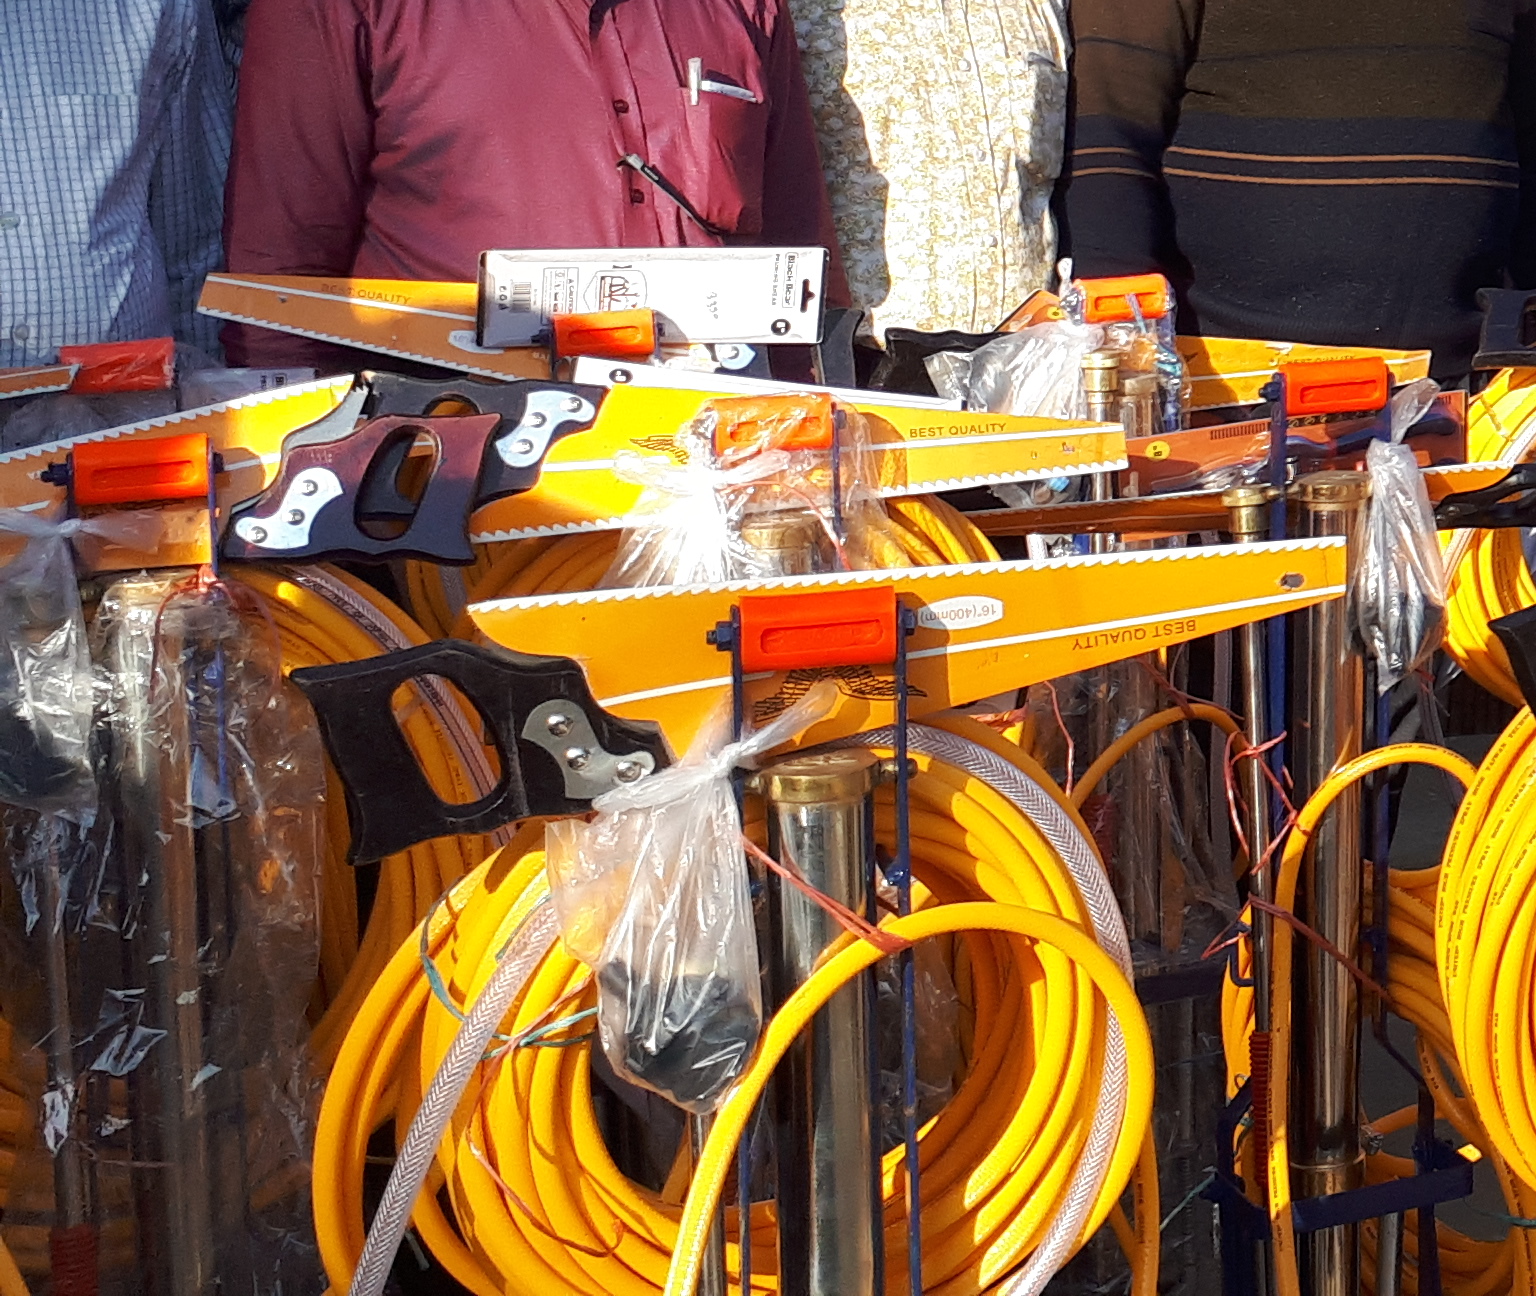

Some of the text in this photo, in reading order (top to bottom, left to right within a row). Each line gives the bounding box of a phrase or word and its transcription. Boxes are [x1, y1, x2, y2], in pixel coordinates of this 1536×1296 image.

[357, 289, 412, 306] QUALITY
[909, 422, 1007, 440] BEST QUALITY
[1072, 618, 1198, 652] BEST QUALITY
